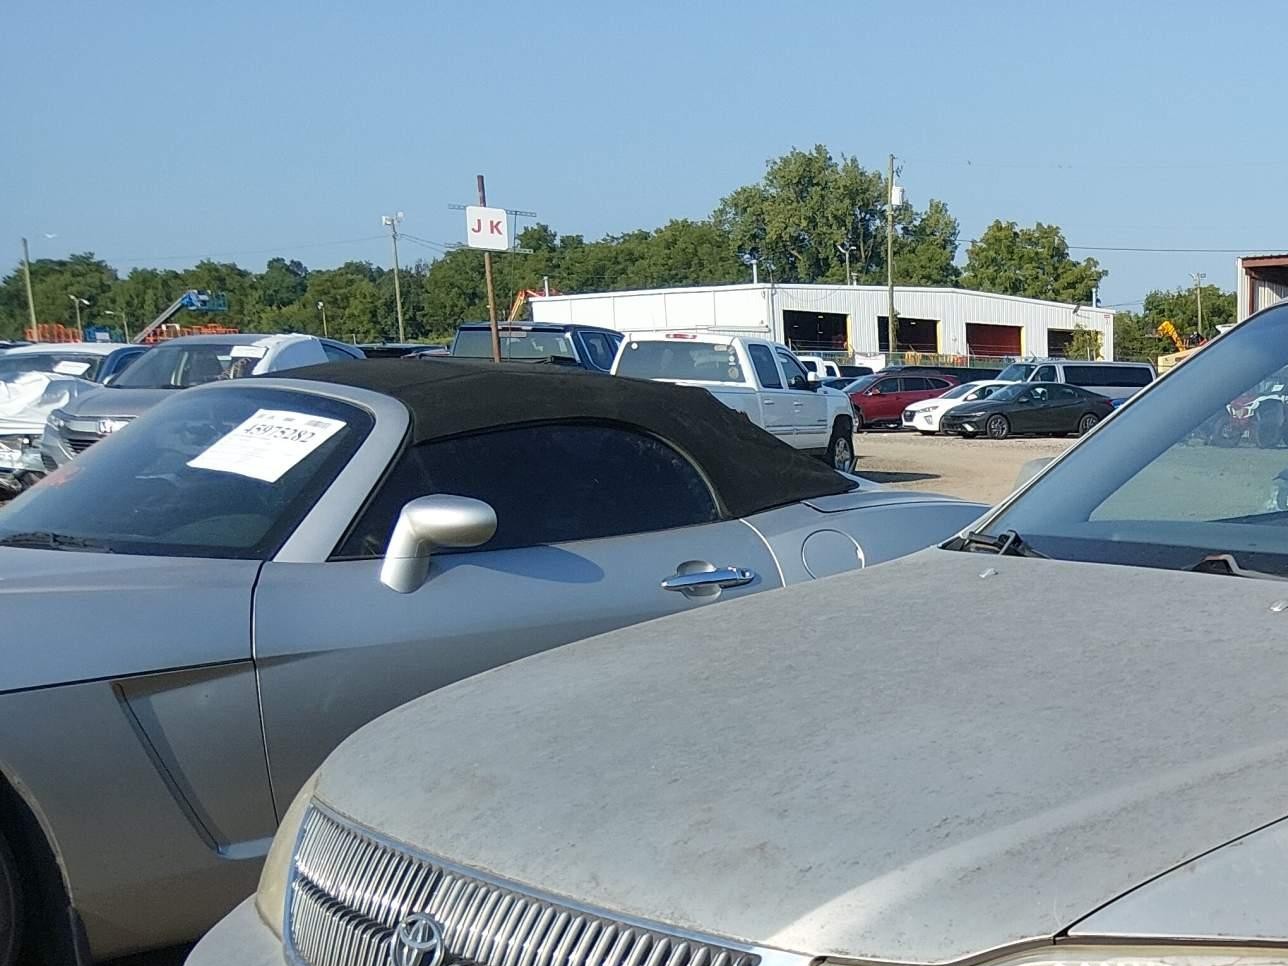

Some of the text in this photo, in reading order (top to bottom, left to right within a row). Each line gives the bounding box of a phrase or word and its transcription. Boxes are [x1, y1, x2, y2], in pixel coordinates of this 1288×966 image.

[471, 218, 503, 235] J K
[244, 423, 316, 443] 45975282
